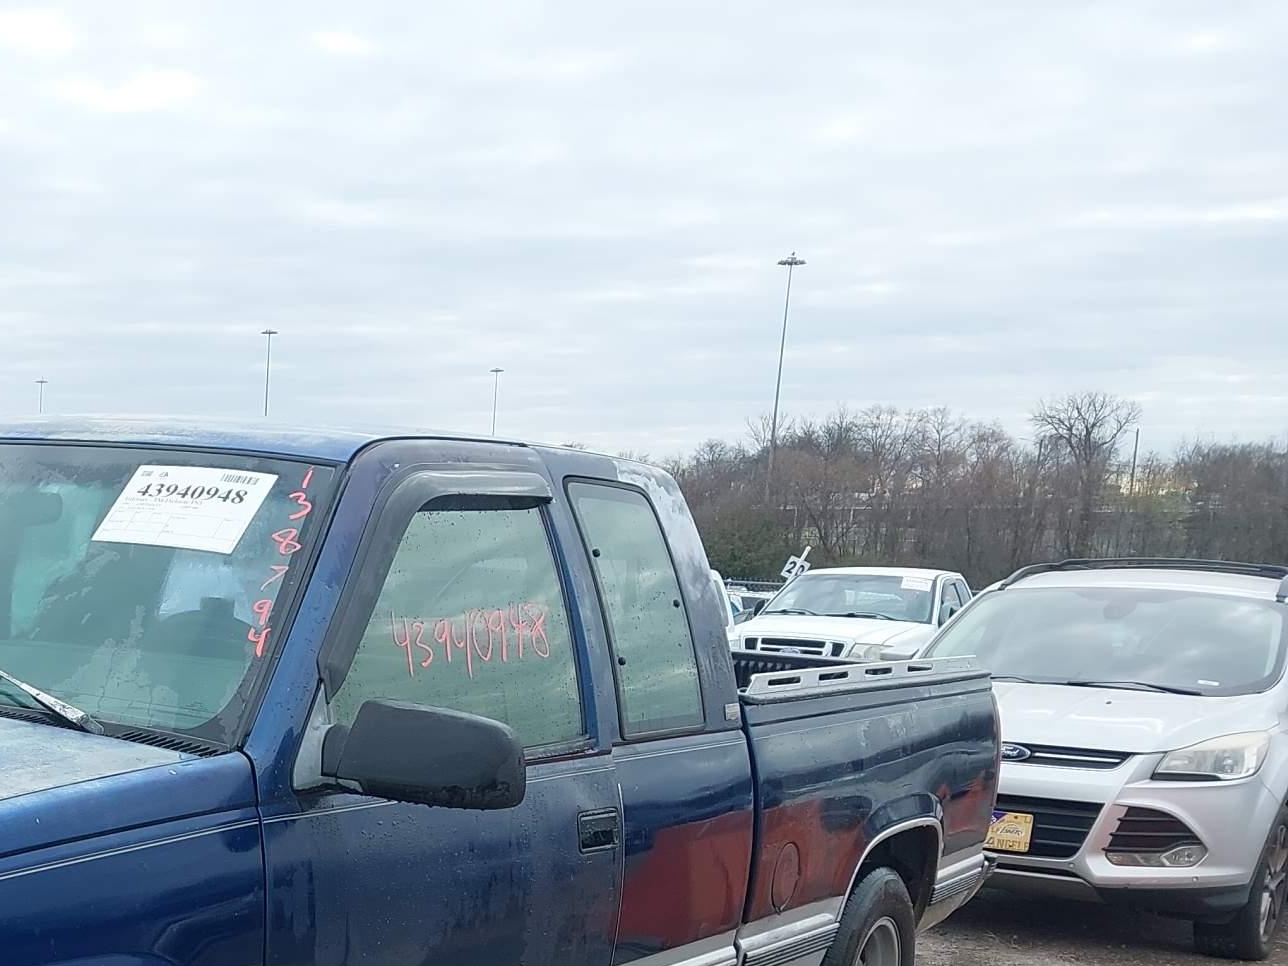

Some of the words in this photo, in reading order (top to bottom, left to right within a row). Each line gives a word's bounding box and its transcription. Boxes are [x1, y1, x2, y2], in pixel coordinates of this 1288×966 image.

[137, 483, 248, 504] 43940948
[785, 560, 805, 577] 20
[391, 603, 550, 680] 43940948
